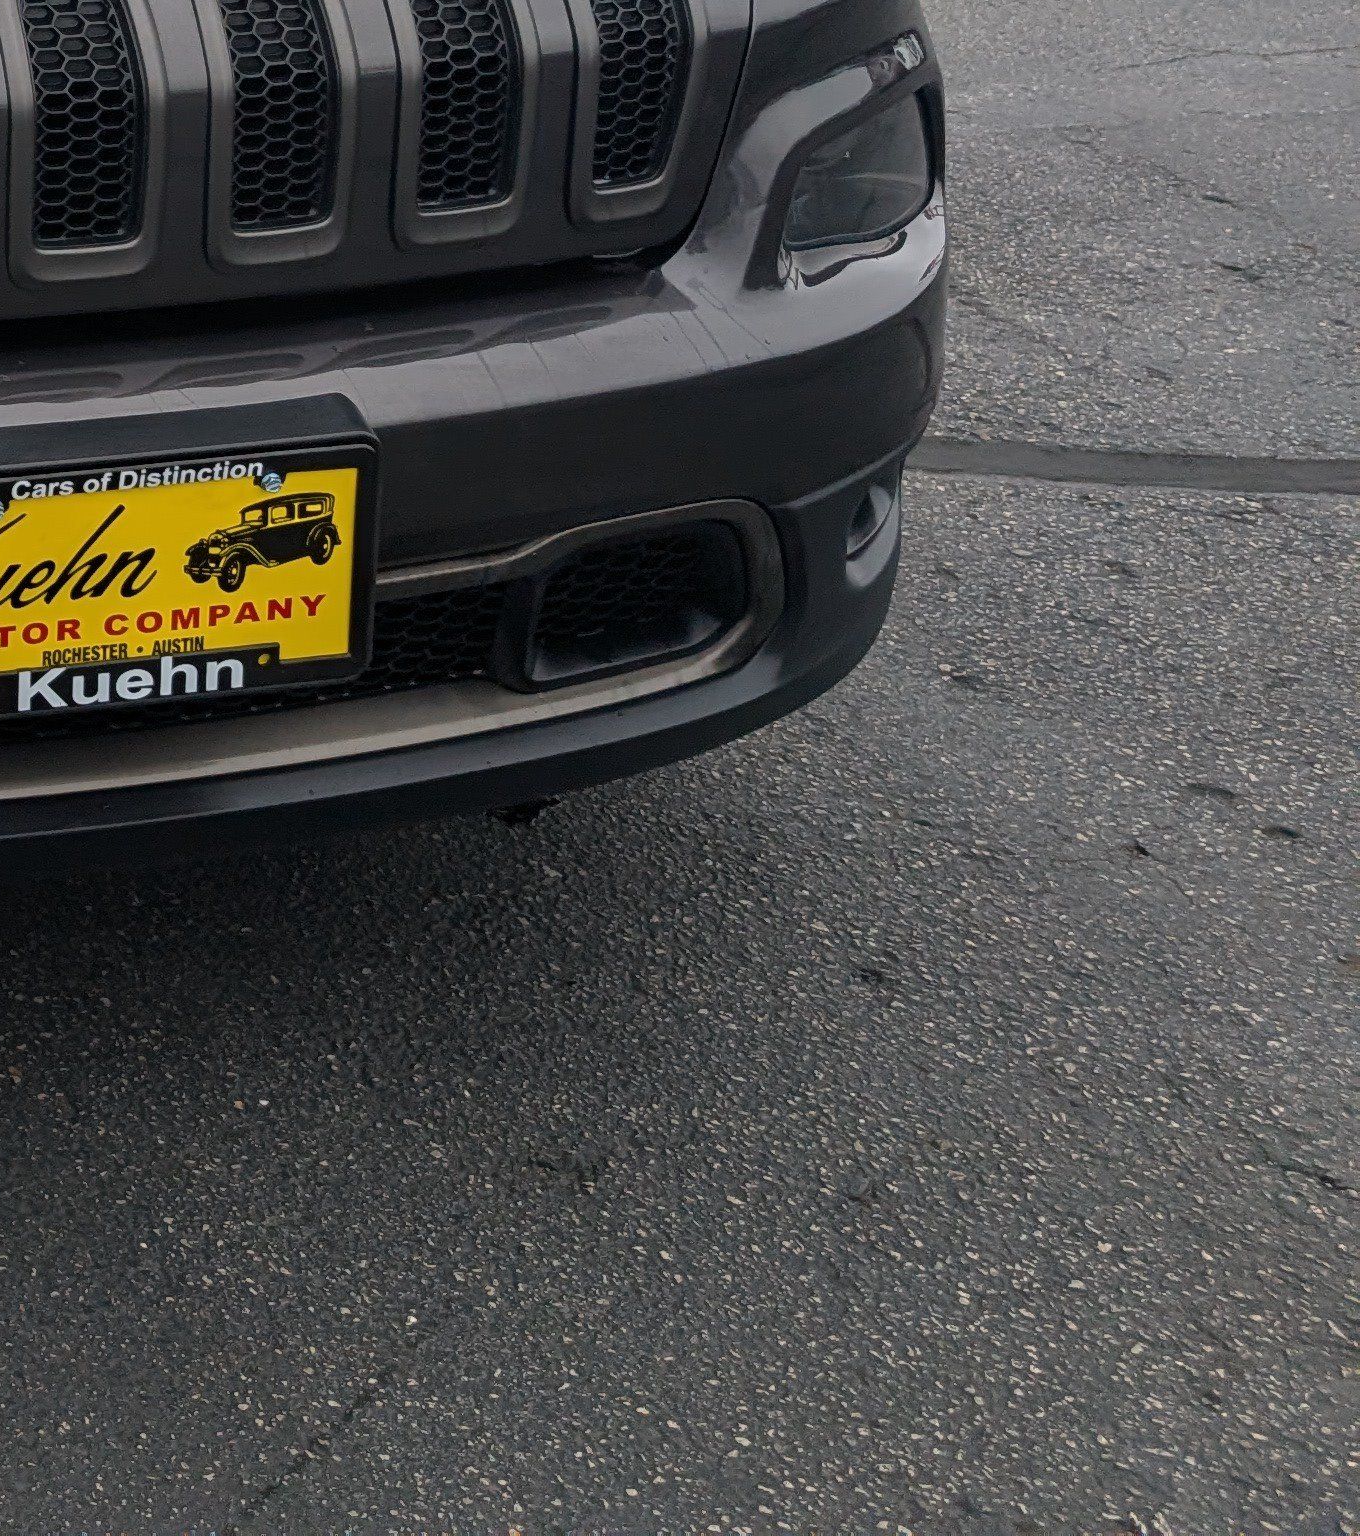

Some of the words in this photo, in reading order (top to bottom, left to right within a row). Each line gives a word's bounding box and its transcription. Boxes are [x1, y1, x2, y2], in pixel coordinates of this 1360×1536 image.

[11, 479, 74, 501] Cars
[82, 472, 112, 494] of
[118, 460, 264, 491] Distinction
[103, 593, 327, 636] COMPANY
[42, 642, 129, 667] ROCHESTER
[151, 635, 206, 657] AUSTIN
[17, 655, 245, 712] Kuehn
